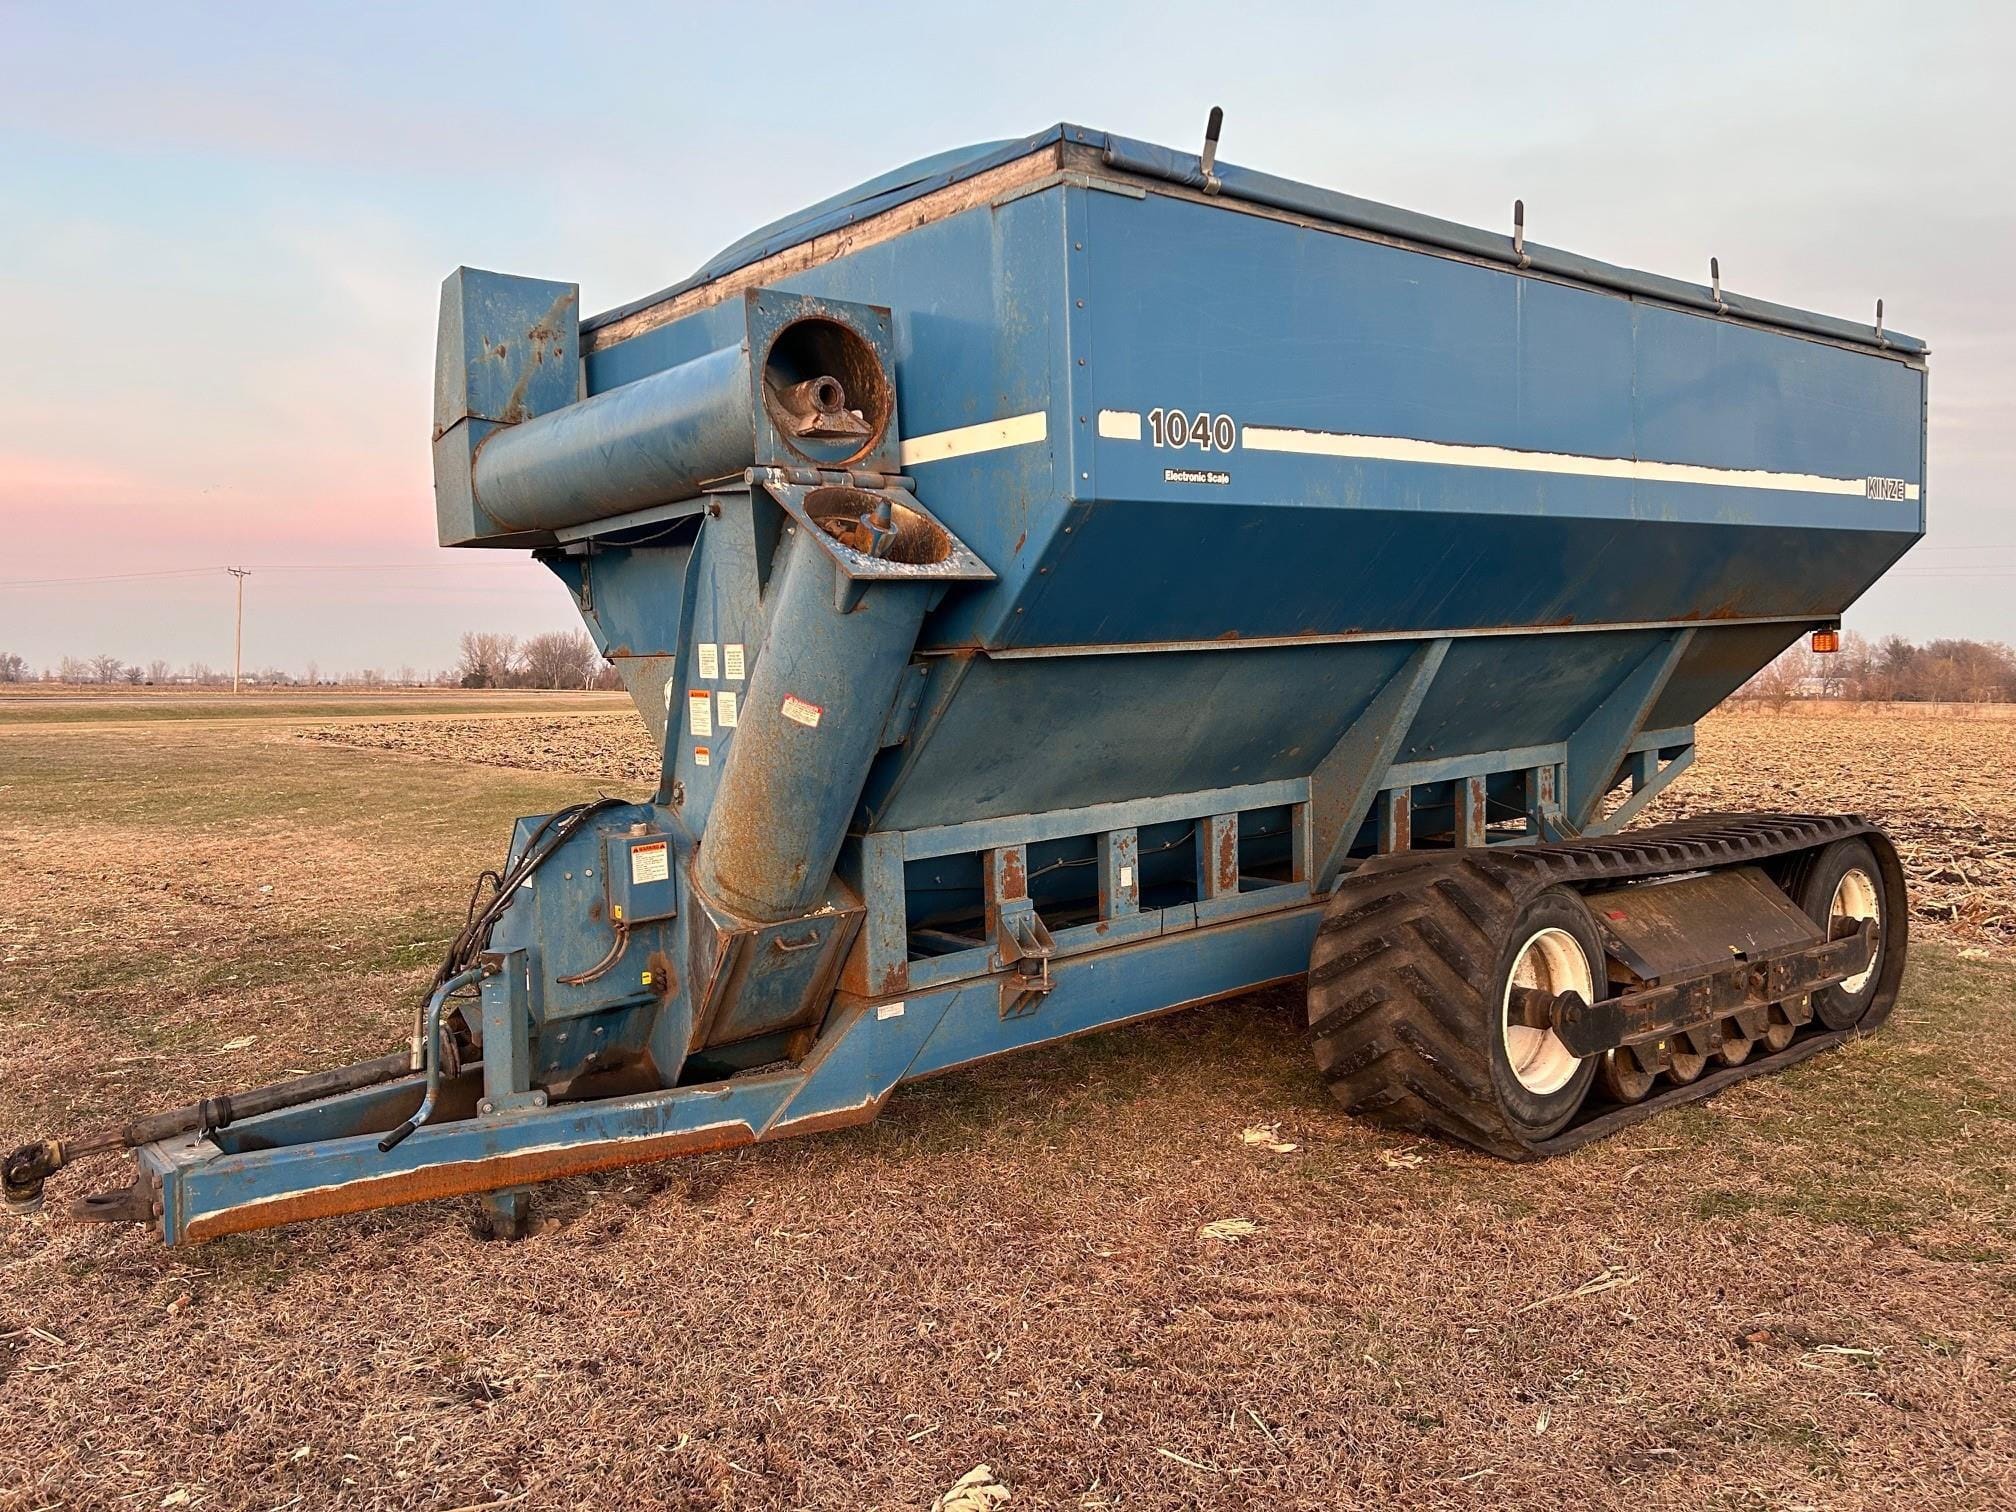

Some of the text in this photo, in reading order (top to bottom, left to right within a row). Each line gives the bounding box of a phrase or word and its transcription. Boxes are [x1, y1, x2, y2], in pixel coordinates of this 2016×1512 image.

[1148, 408, 1236, 453] 1040
[1165, 469, 1230, 484] Electronic Scale
[1867, 476, 1904, 501] KINZE
